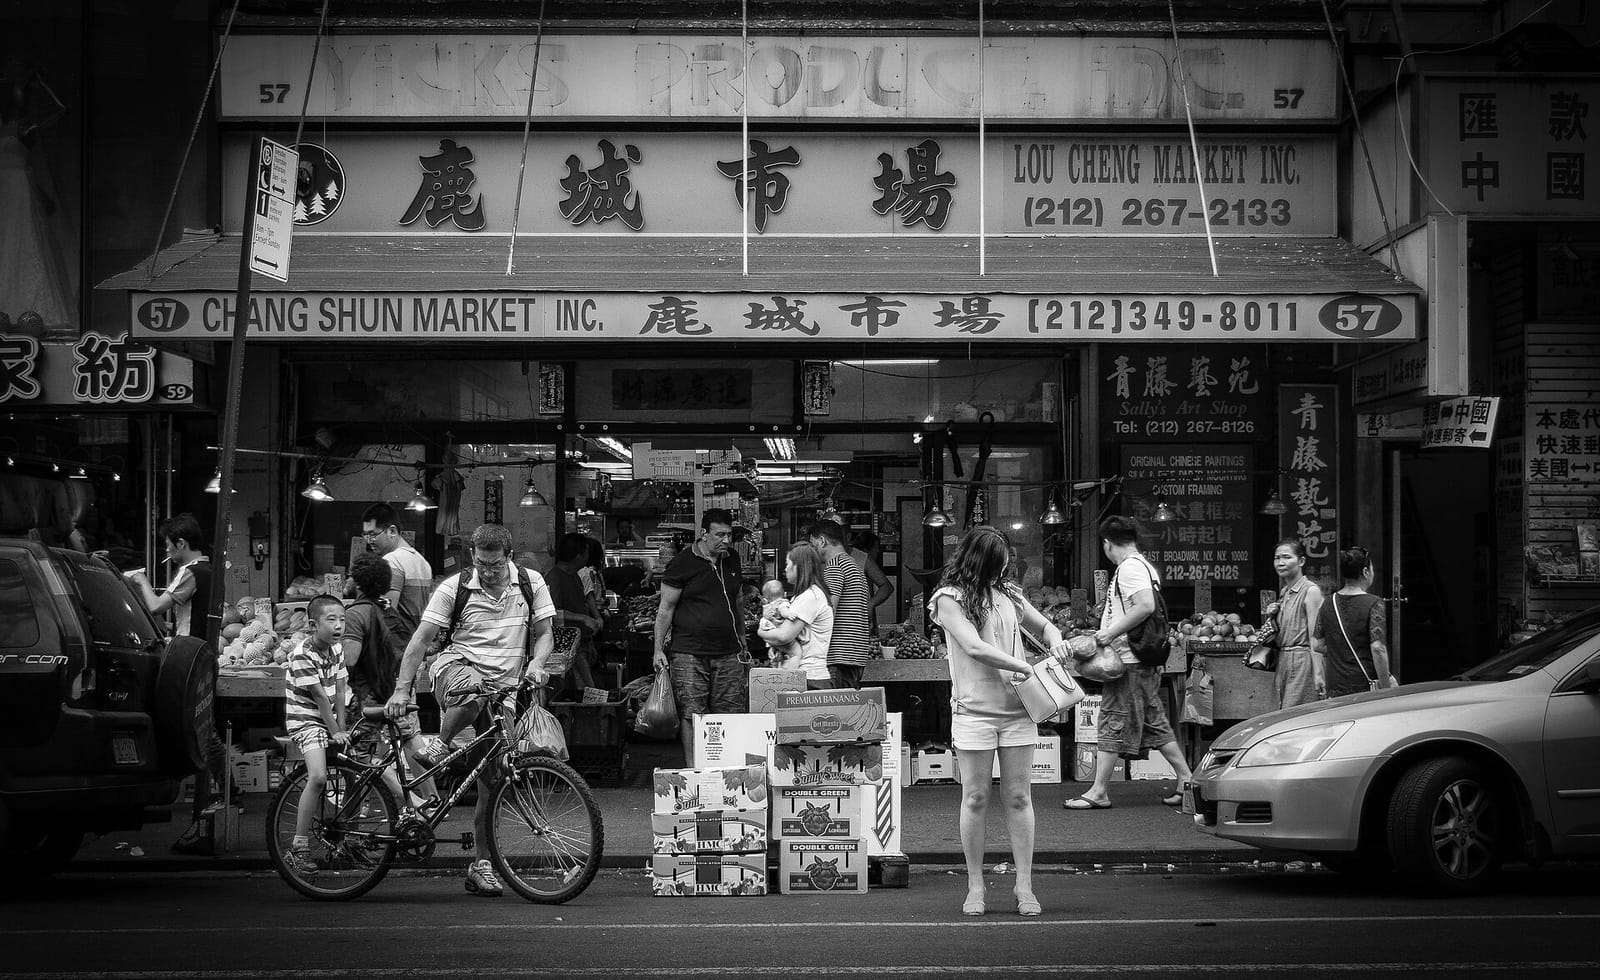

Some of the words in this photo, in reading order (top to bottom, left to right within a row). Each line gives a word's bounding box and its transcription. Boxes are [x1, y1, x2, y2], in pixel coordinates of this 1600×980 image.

[259, 83, 290, 103] 57
[1274, 89, 1304, 109] 57
[1014, 144, 1055, 184] LOU
[1068, 143, 1140, 184] CHENG
[1153, 144, 1247, 184] MARKET
[1260, 144, 1300, 184] INC.
[398, 138, 957, 233] 鹿城市場
[1461, 152, 1585, 201] 中國
[1024, 197, 1103, 227] (212)
[1121, 198, 1291, 226] 267-2133
[151, 303, 177, 329] 57
[203, 297, 307, 332] CHANG
[319, 297, 402, 332] SHUN
[414, 297, 535, 332] MARKET
[556, 299, 603, 331] INC.
[639, 296, 1005, 336] 鹿城市場
[1336, 304, 1384, 331] 57
[1106, 355, 1259, 399] 青藤藝苑
[166, 386, 187, 399] 59
[1119, 399, 1167, 418] Sally's
[1175, 400, 1201, 416] Art
[1209, 399, 1247, 418] Shop
[1113, 421, 1138, 434] Tel:
[1146, 421, 1179, 436] (212)
[1187, 421, 1254, 434] 267-8126
[1130, 455, 1166, 467] ORIGINAL
[1169, 455, 1202, 467] CHINESE
[1205, 455, 1245, 467] PAINTINGS
[1187, 484, 1223, 496] FRAMING
[1143, 551, 1160, 561] EAST
[1165, 564, 1240, 580] 212-267-8126
[785, 694, 823, 706] PREMIUM
[823, 692, 861, 705] BANANAS
